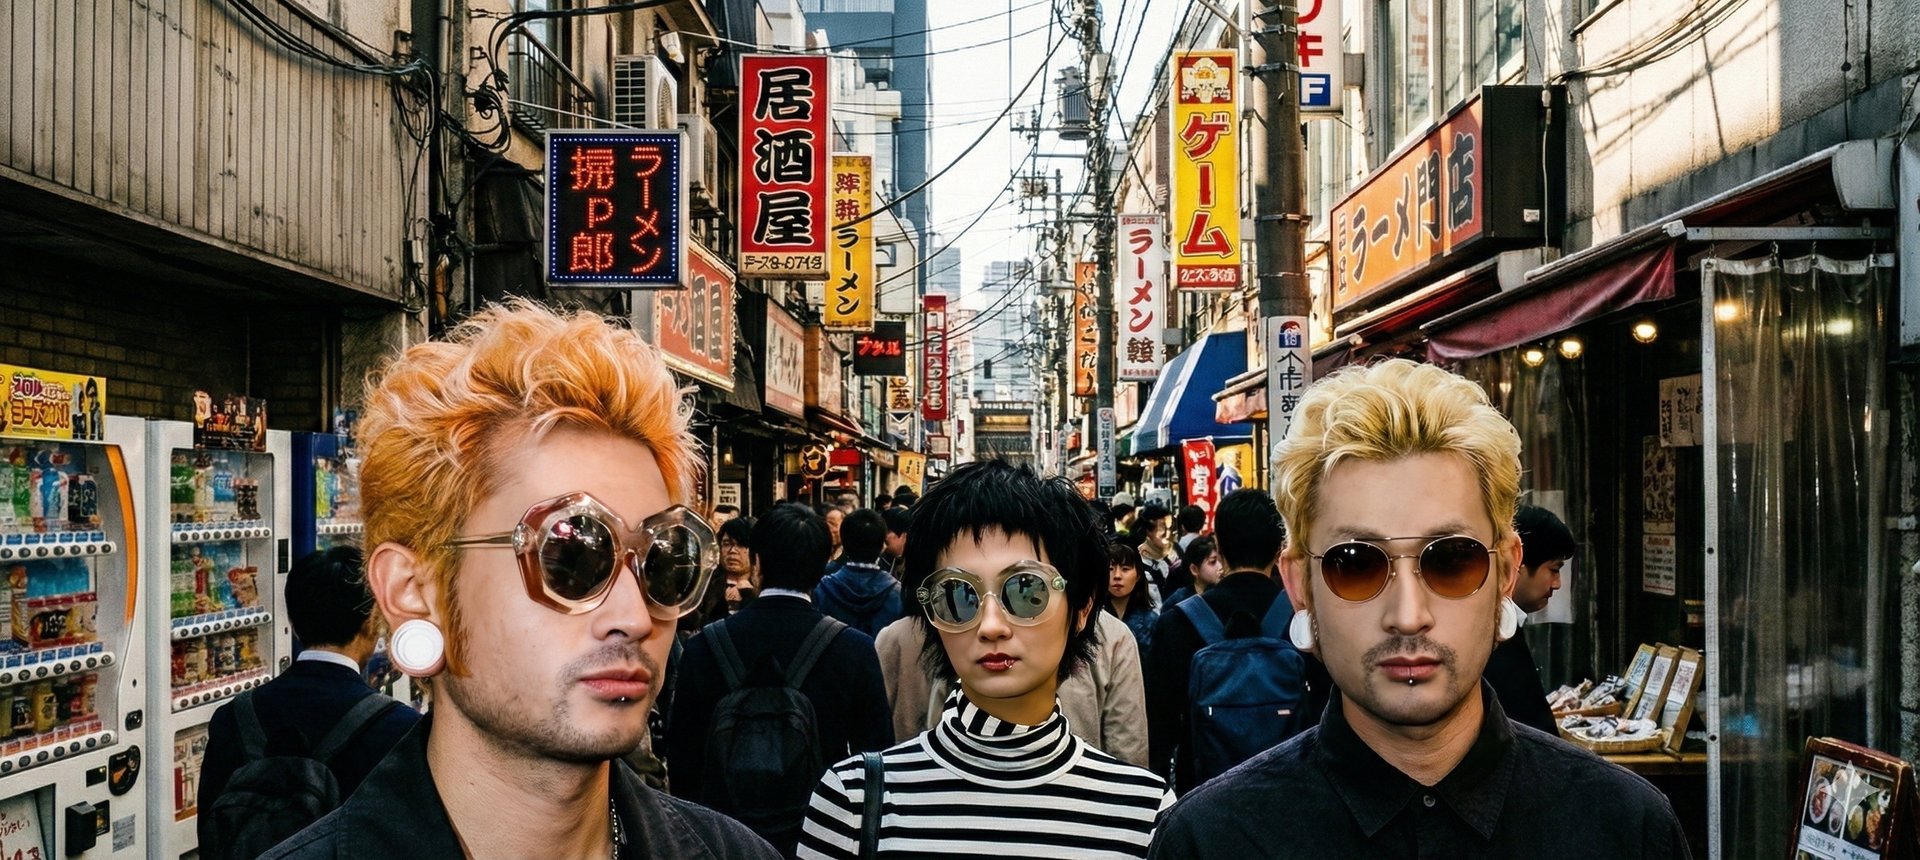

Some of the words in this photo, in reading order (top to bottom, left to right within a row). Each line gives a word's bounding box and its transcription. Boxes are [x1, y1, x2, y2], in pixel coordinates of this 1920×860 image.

[753, 66, 814, 246] 居酒屋
[1301, 77, 1326, 104] F
[630, 146, 662, 273] ラーメン
[1179, 111, 1234, 259] ゲーム
